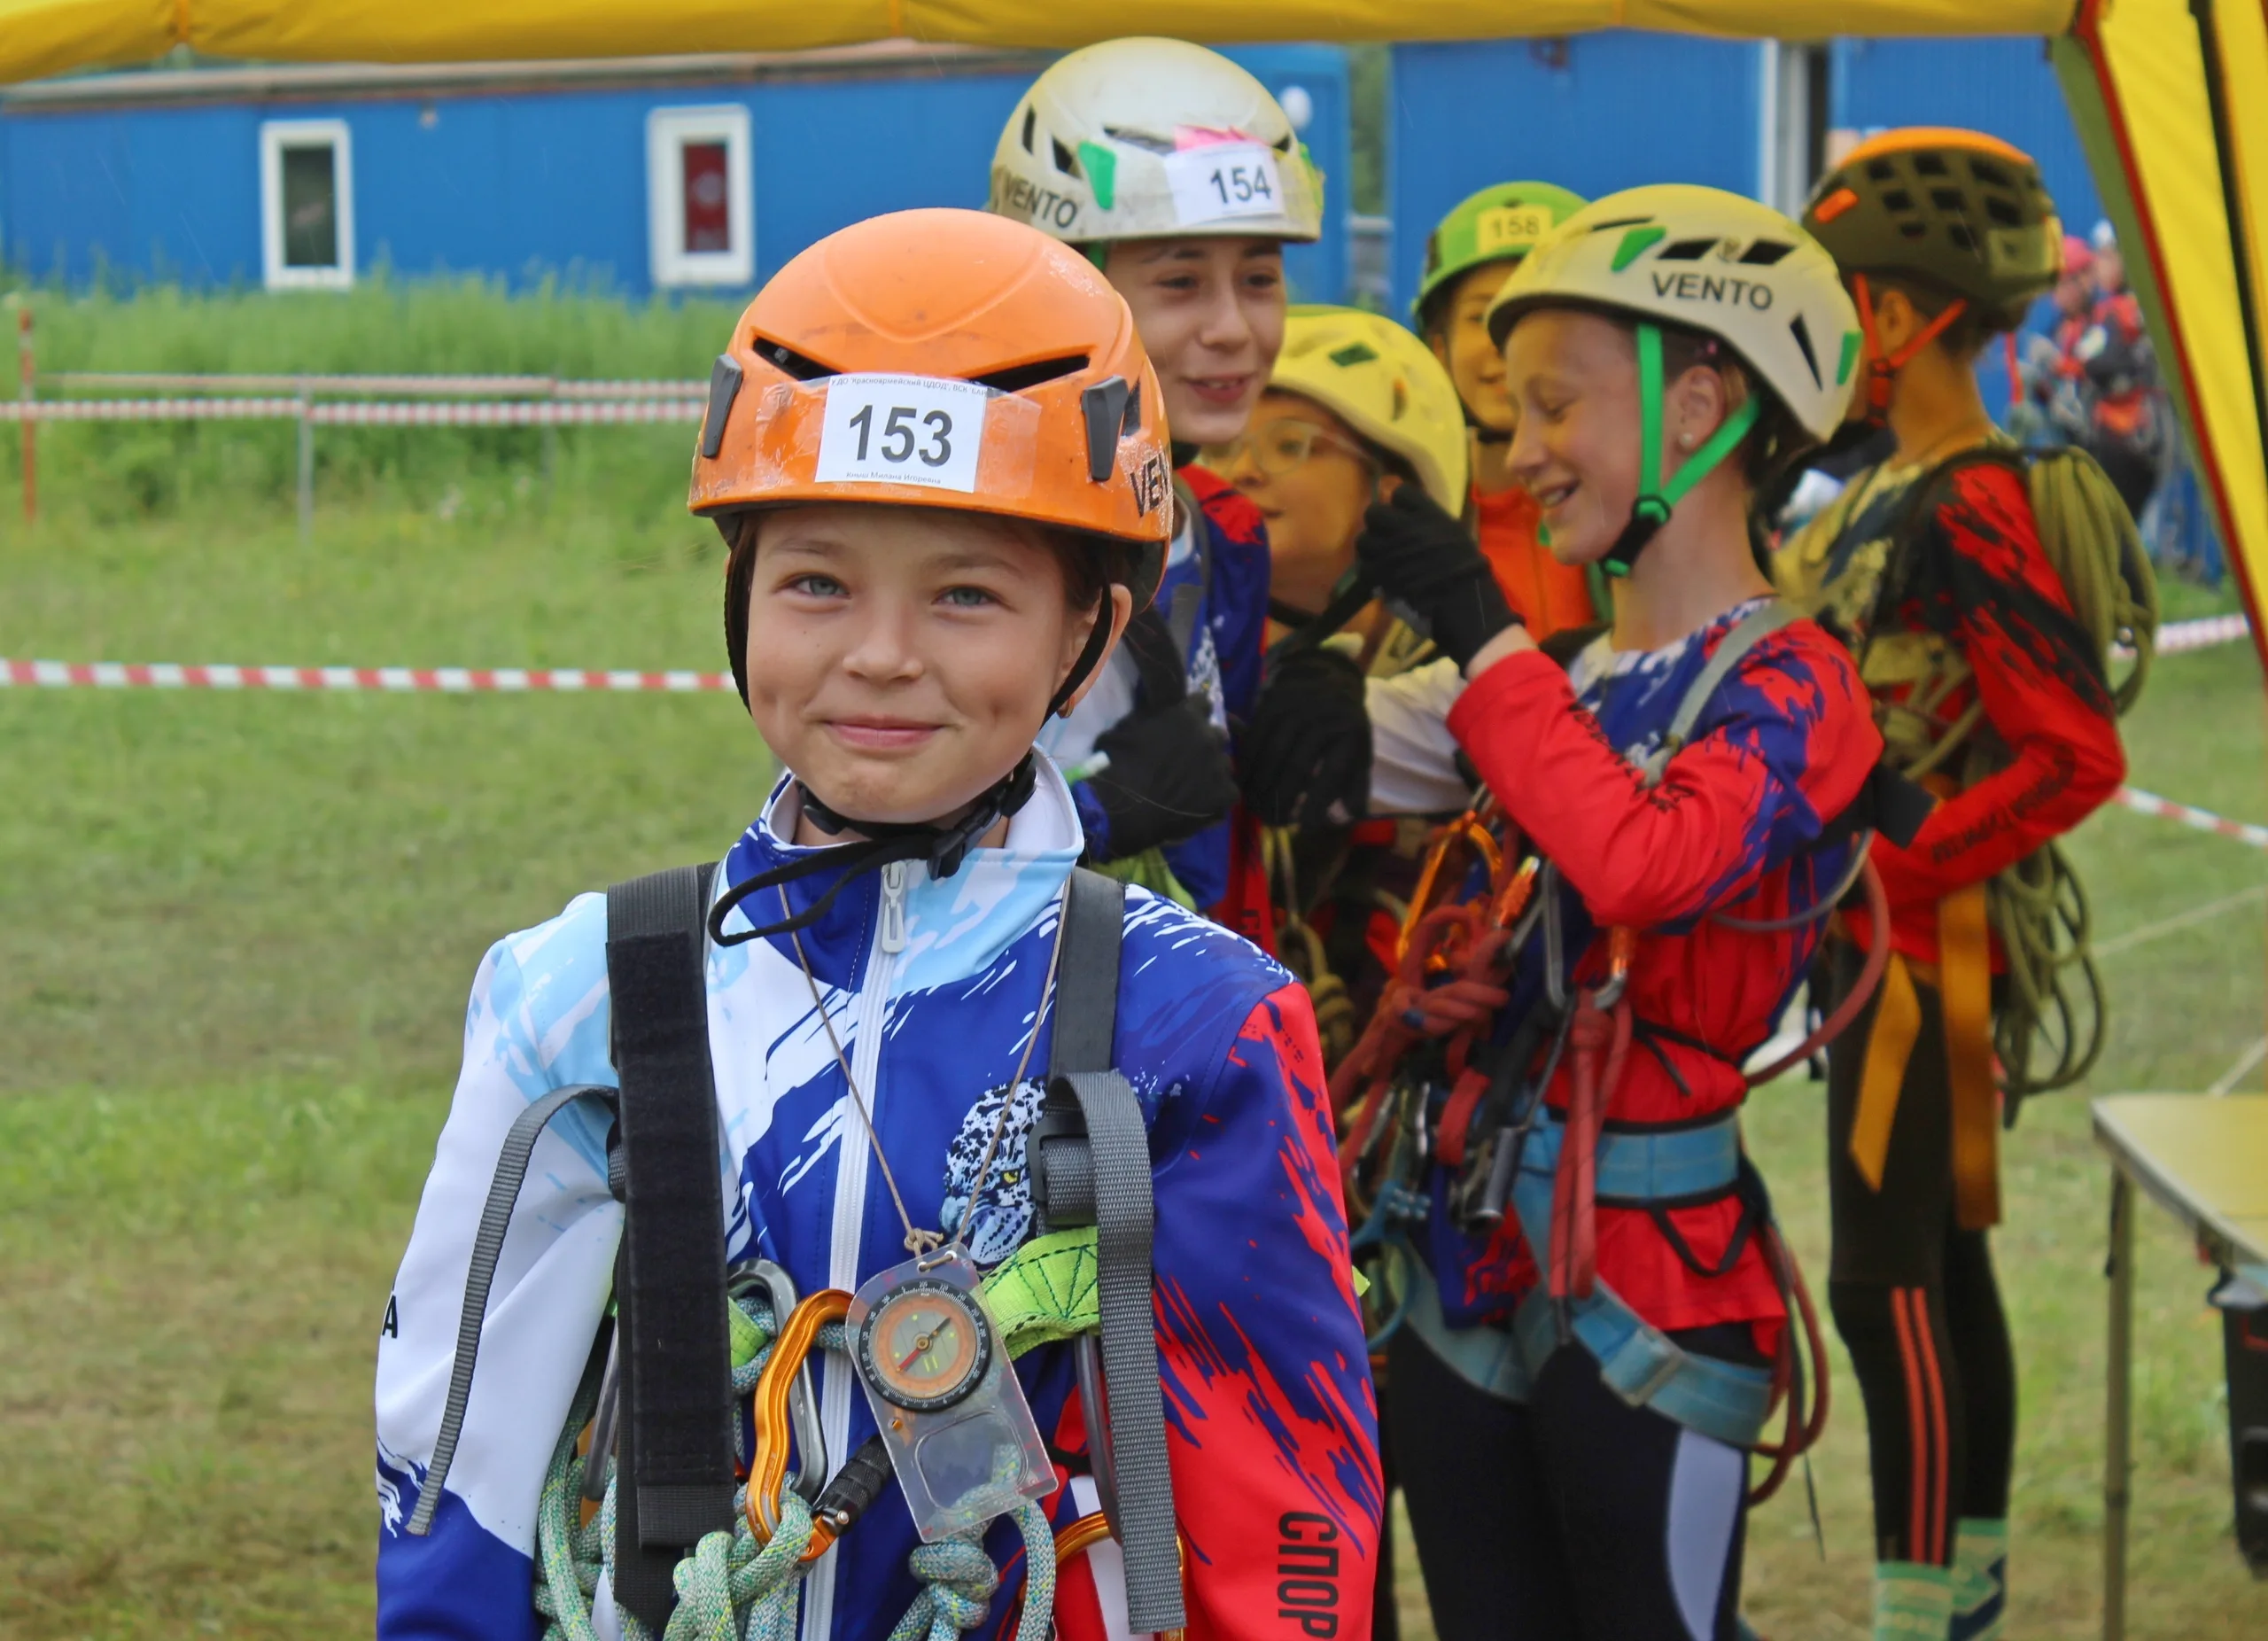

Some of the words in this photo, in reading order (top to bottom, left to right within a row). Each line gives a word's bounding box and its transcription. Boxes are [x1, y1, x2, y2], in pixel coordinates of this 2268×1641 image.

[1210, 165, 1271, 204] 154
[1492, 215, 1540, 238] 158
[1651, 271, 1773, 310] VENTO
[850, 405, 952, 467] 153
[870, 471, 902, 480] Милана
[904, 473, 941, 484] Игоревна
[1278, 1512, 1339, 1639] СПОР
